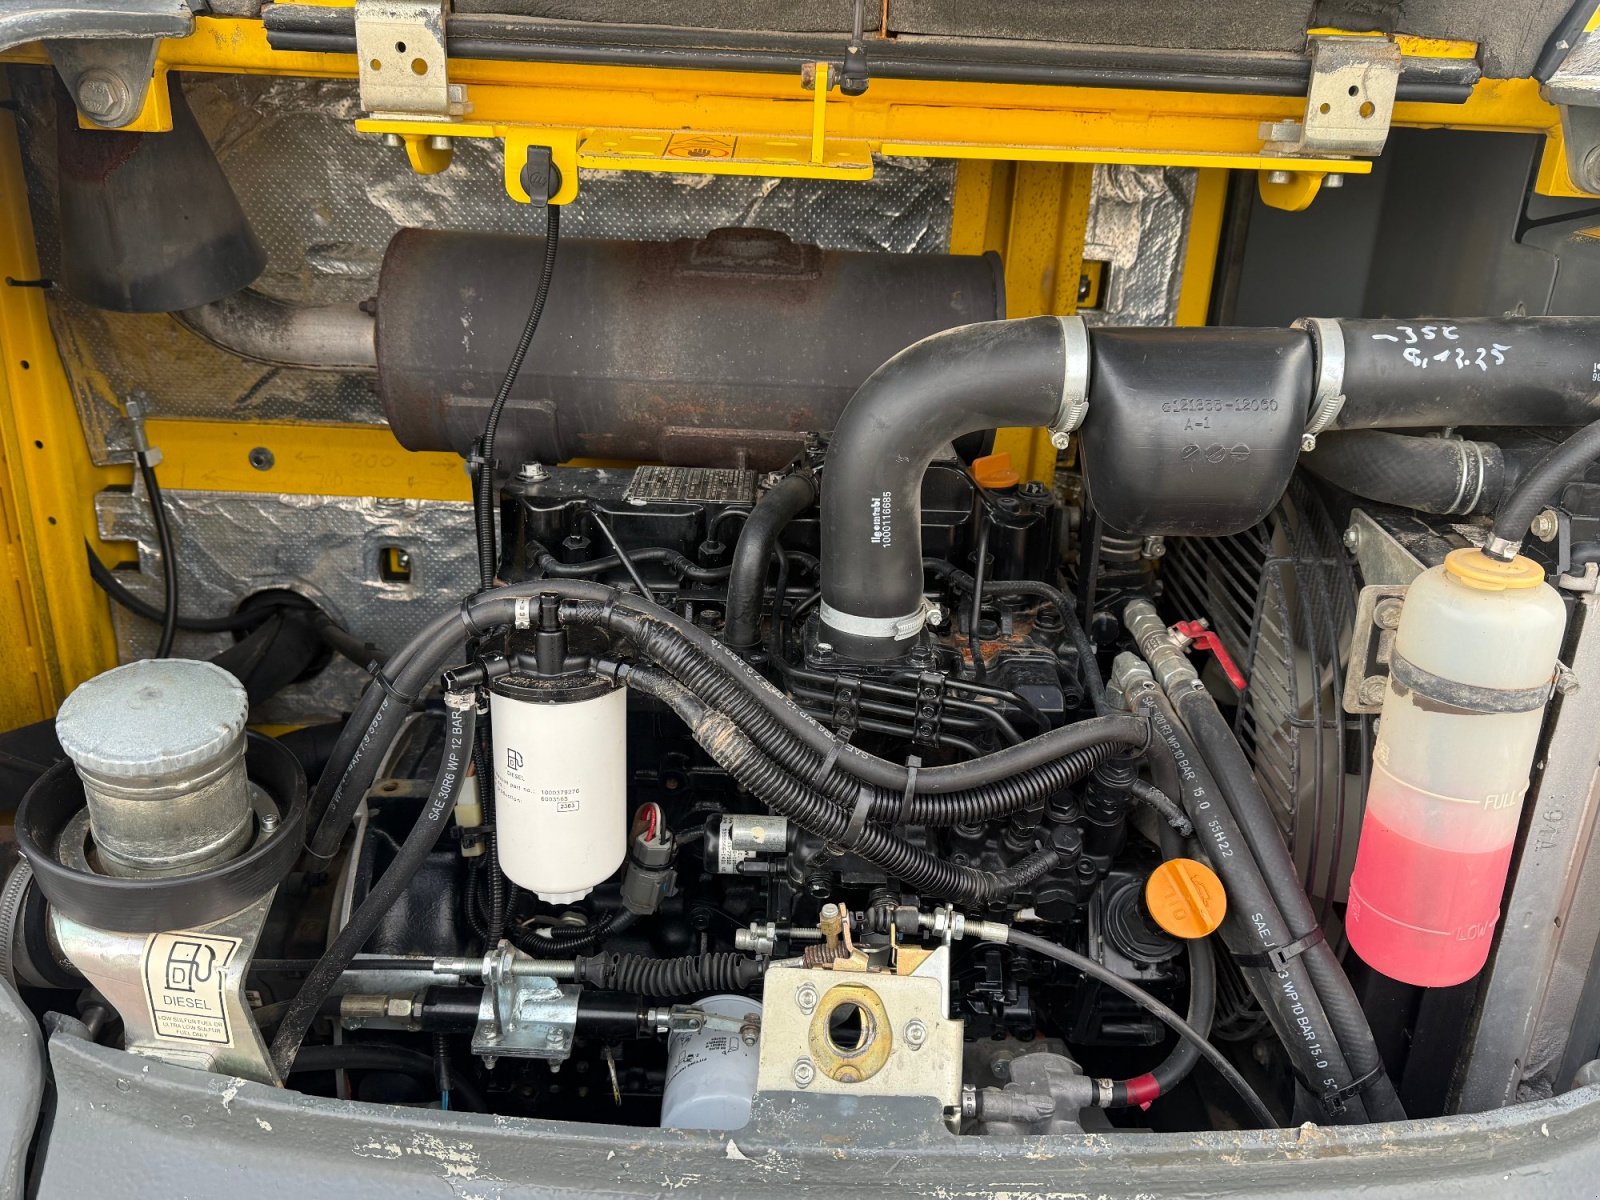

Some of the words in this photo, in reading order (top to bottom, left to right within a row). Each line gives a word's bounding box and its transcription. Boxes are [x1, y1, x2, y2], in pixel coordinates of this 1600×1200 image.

[882, 491, 891, 548] 1000116685
[451, 710, 462, 735] BAR
[451, 738, 462, 749] 12
[447, 753, 459, 771] WP
[438, 772, 455, 799] 30R6
[1160, 721, 1173, 735] R3
[1178, 758, 1196, 782] BAR
[1208, 819, 1234, 859] 55H22
[428, 799, 446, 821] SAE
[1483, 791, 1517, 810] FULL
[1251, 912, 1272, 938] SAE
[1456, 923, 1489, 941] LOW
[1282, 980, 1298, 1002] WP
[163, 995, 212, 1011] DIESEL
[1291, 1001, 1305, 1016] 10
[1296, 1014, 1316, 1042] BAR
